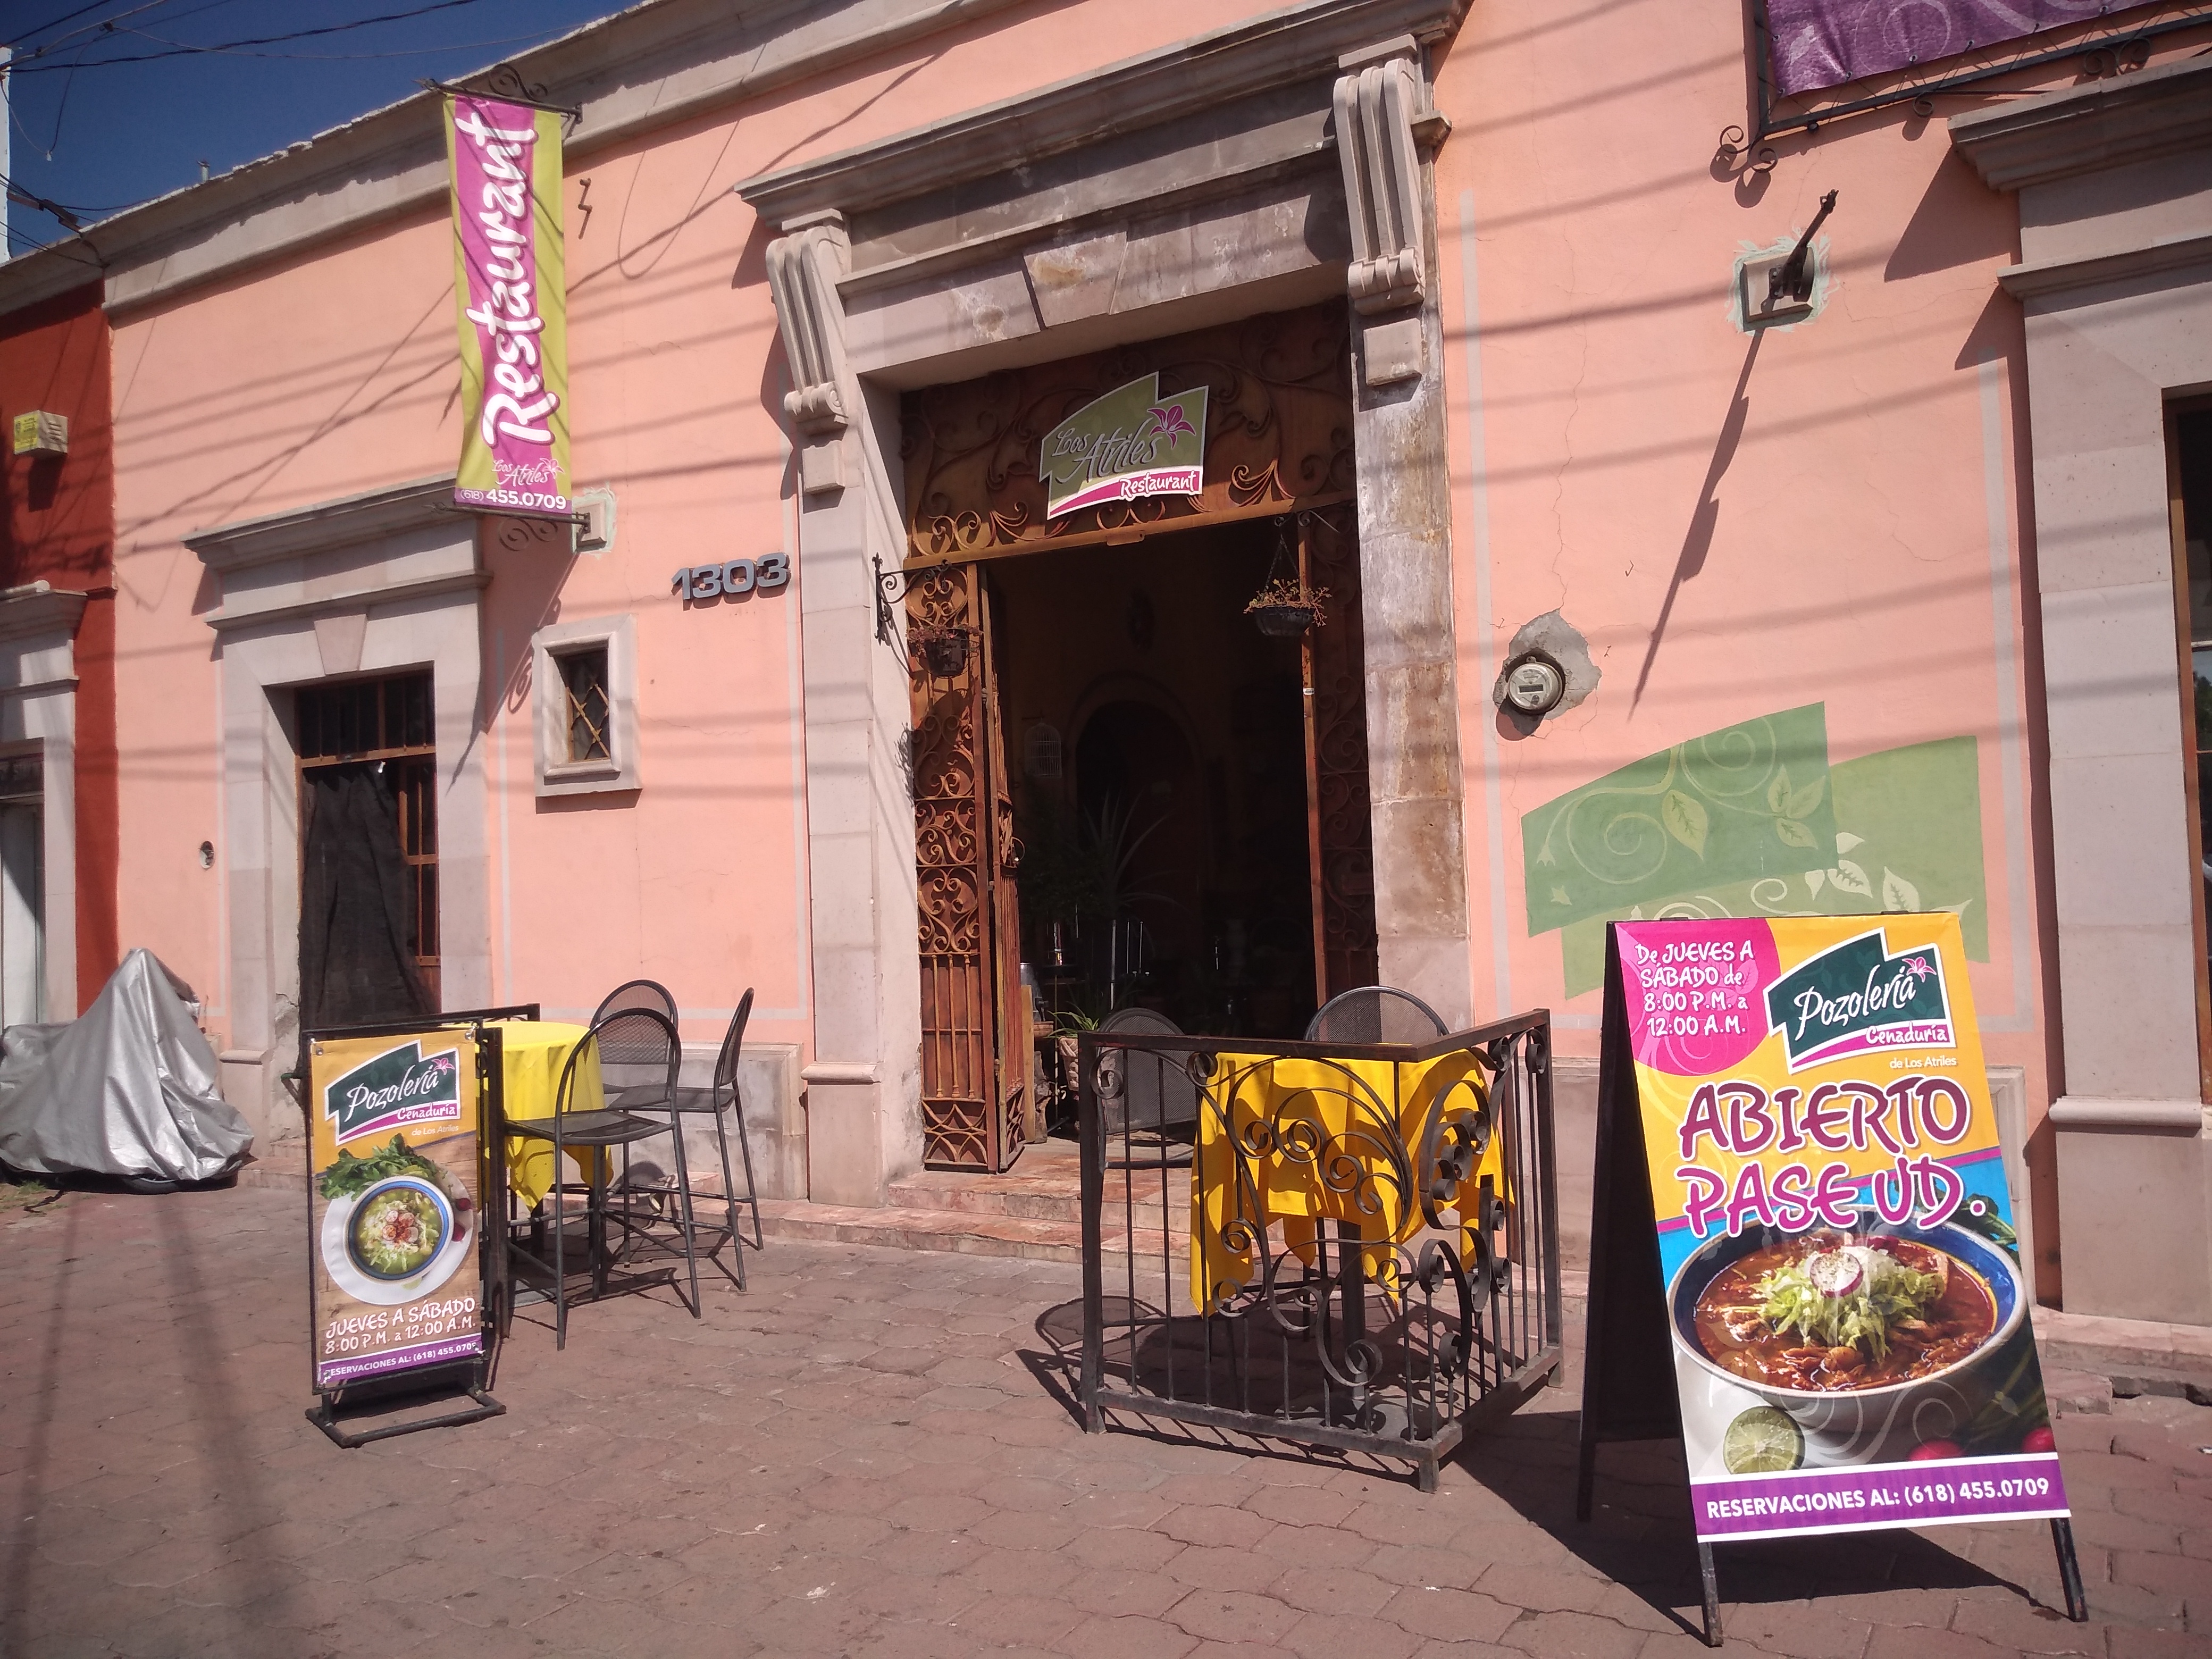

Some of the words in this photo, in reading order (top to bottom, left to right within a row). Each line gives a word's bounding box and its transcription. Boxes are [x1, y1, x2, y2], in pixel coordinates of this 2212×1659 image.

[455, 112, 559, 448] Restaurant
[1052, 428, 1092, 457] Los
[491, 459, 514, 472] Los
[1118, 470, 1196, 497] Restaurant
[460, 489, 484, 501] (618)
[487, 489, 566, 509] 455.0709
[672, 552, 791, 600] 1303
[1635, 943, 1657, 965] De
[1662, 941, 1735, 964] JUEVES
[1739, 940, 1754, 961] A
[1640, 962, 1719, 988] SÁBADO
[1724, 963, 1743, 985] de
[1644, 991, 1687, 1012] 8:00
[1689, 991, 1732, 1012] P.M.
[1738, 996, 1749, 1009] a
[1647, 1015, 1699, 1036] 12:00
[1704, 1014, 1746, 1036] A.M.
[1866, 1021, 1948, 1044] Cenaduría
[1889, 1058, 1903, 1069] de
[1905, 1057, 1922, 1068] Los
[1924, 1055, 1957, 1068] Atriles
[397, 1102, 456, 1120] Cenaduría
[1678, 1073, 1971, 1161] ABIERTO
[423, 1126, 435, 1135] Los
[437, 1124, 459, 1133] Atriles
[1674, 1160, 1859, 1239] PASE
[1871, 1153, 1987, 1231] UD.
[325, 1312, 389, 1339] JUEVES
[392, 1308, 404, 1327] A
[408, 1297, 476, 1322] SÁBADO
[325, 1338, 360, 1354] 8:00
[362, 1330, 391, 1348] P.M.
[395, 1332, 403, 1342] a
[405, 1320, 443, 1339] 12:00
[446, 1316, 476, 1333] A.M.
[398, 1356, 412, 1365] AL:
[413, 1351, 436, 1362] (618)
[1707, 1489, 1863, 1519] RESERVACIONES
[1870, 1486, 1900, 1506] AL:
[1904, 1484, 1956, 1507] (618)
[1959, 1477, 2049, 1501] 455.0709
